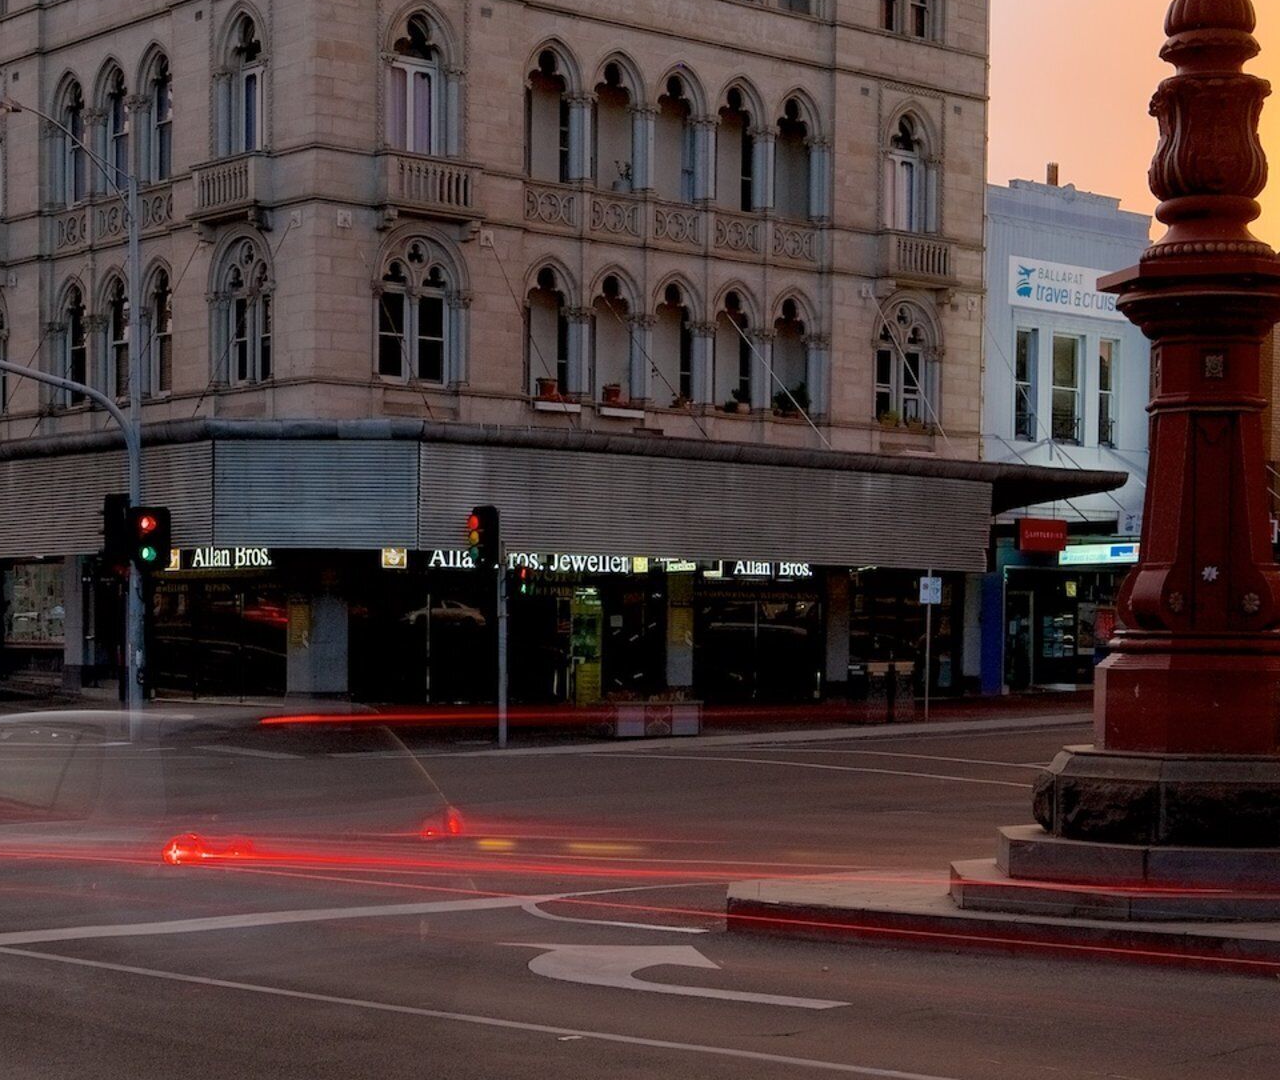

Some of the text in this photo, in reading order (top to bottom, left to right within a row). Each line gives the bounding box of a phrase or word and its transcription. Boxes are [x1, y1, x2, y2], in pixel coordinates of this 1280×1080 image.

[1037, 267, 1084, 285] BALLARAT
[1036, 283, 1117, 312] travel & cruis
[191, 546, 272, 568] Allan Bros.
[427, 549, 477, 569] Alla
[494, 552, 544, 571] ros.
[732, 560, 813, 577] Allan Bros.
